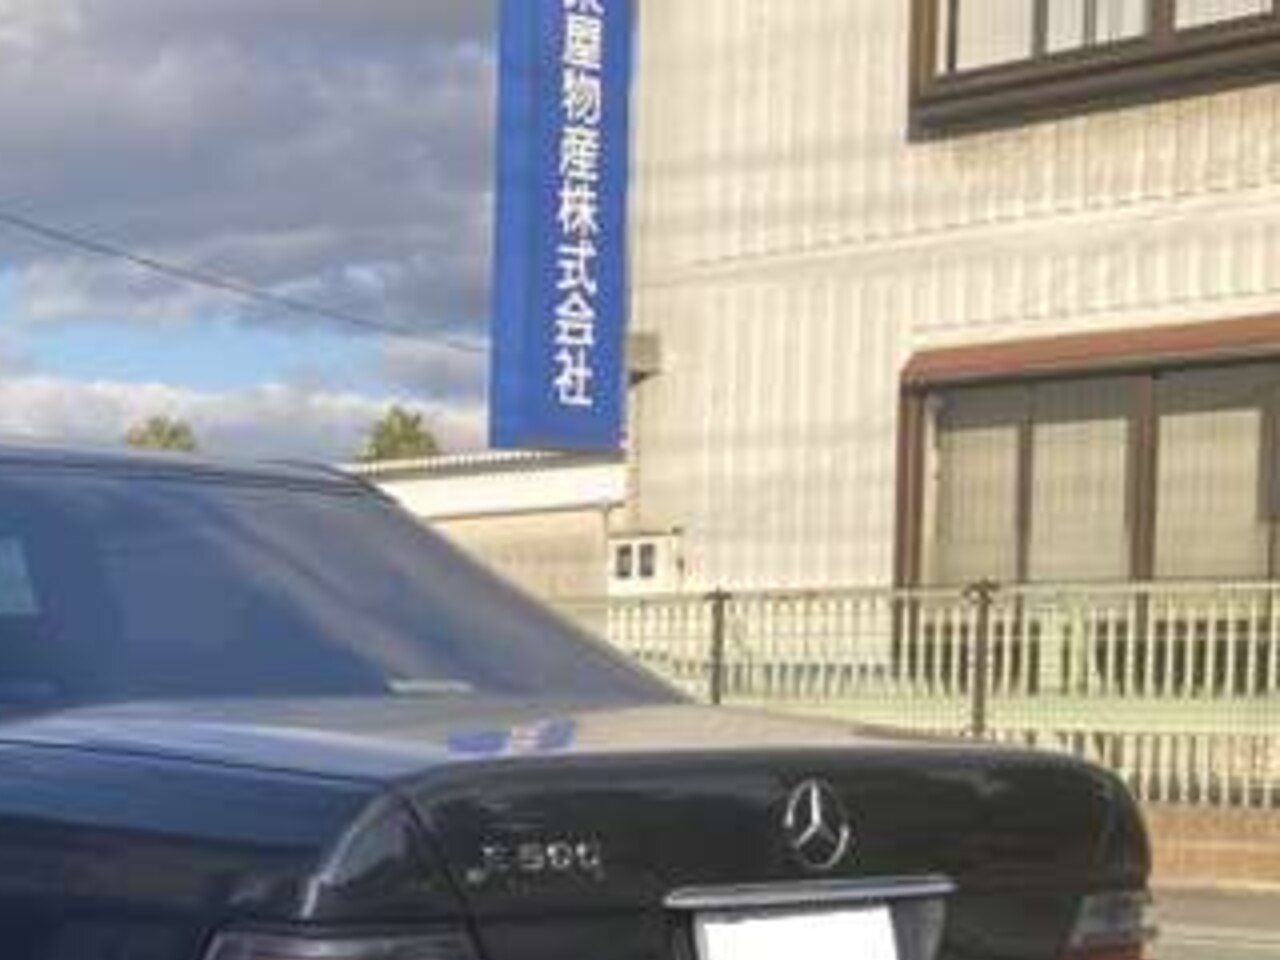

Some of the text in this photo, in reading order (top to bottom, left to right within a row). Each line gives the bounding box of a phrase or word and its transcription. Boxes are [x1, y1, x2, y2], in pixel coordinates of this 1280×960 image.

[554, 0, 605, 406] 屋物産株式会社
